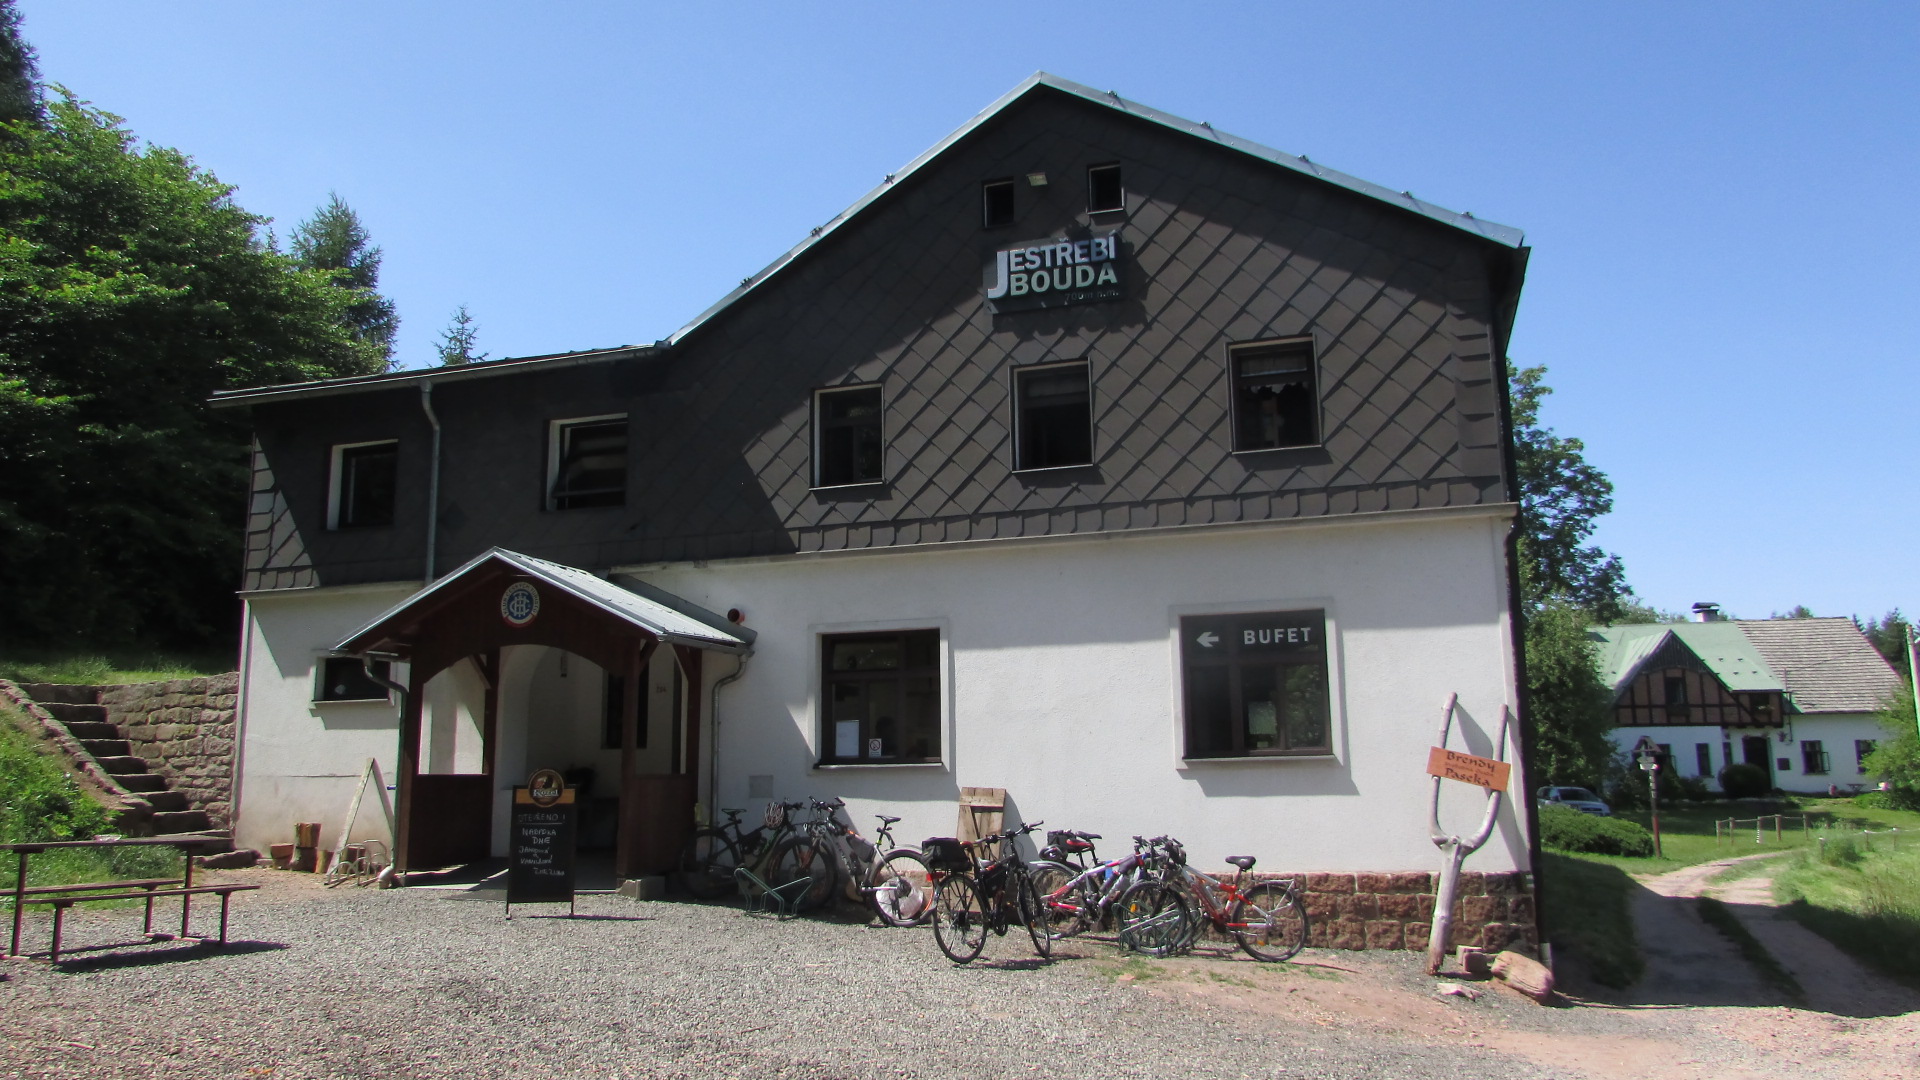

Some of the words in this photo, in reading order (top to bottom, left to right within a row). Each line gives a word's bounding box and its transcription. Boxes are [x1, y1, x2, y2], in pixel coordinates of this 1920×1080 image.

[1010, 262, 1118, 296] BOUDA
[1243, 627, 1312, 645] BUFET
[1446, 751, 1496, 773] Brendy
[532, 788, 560, 798] Kozel
[532, 836, 551, 844] DNE
